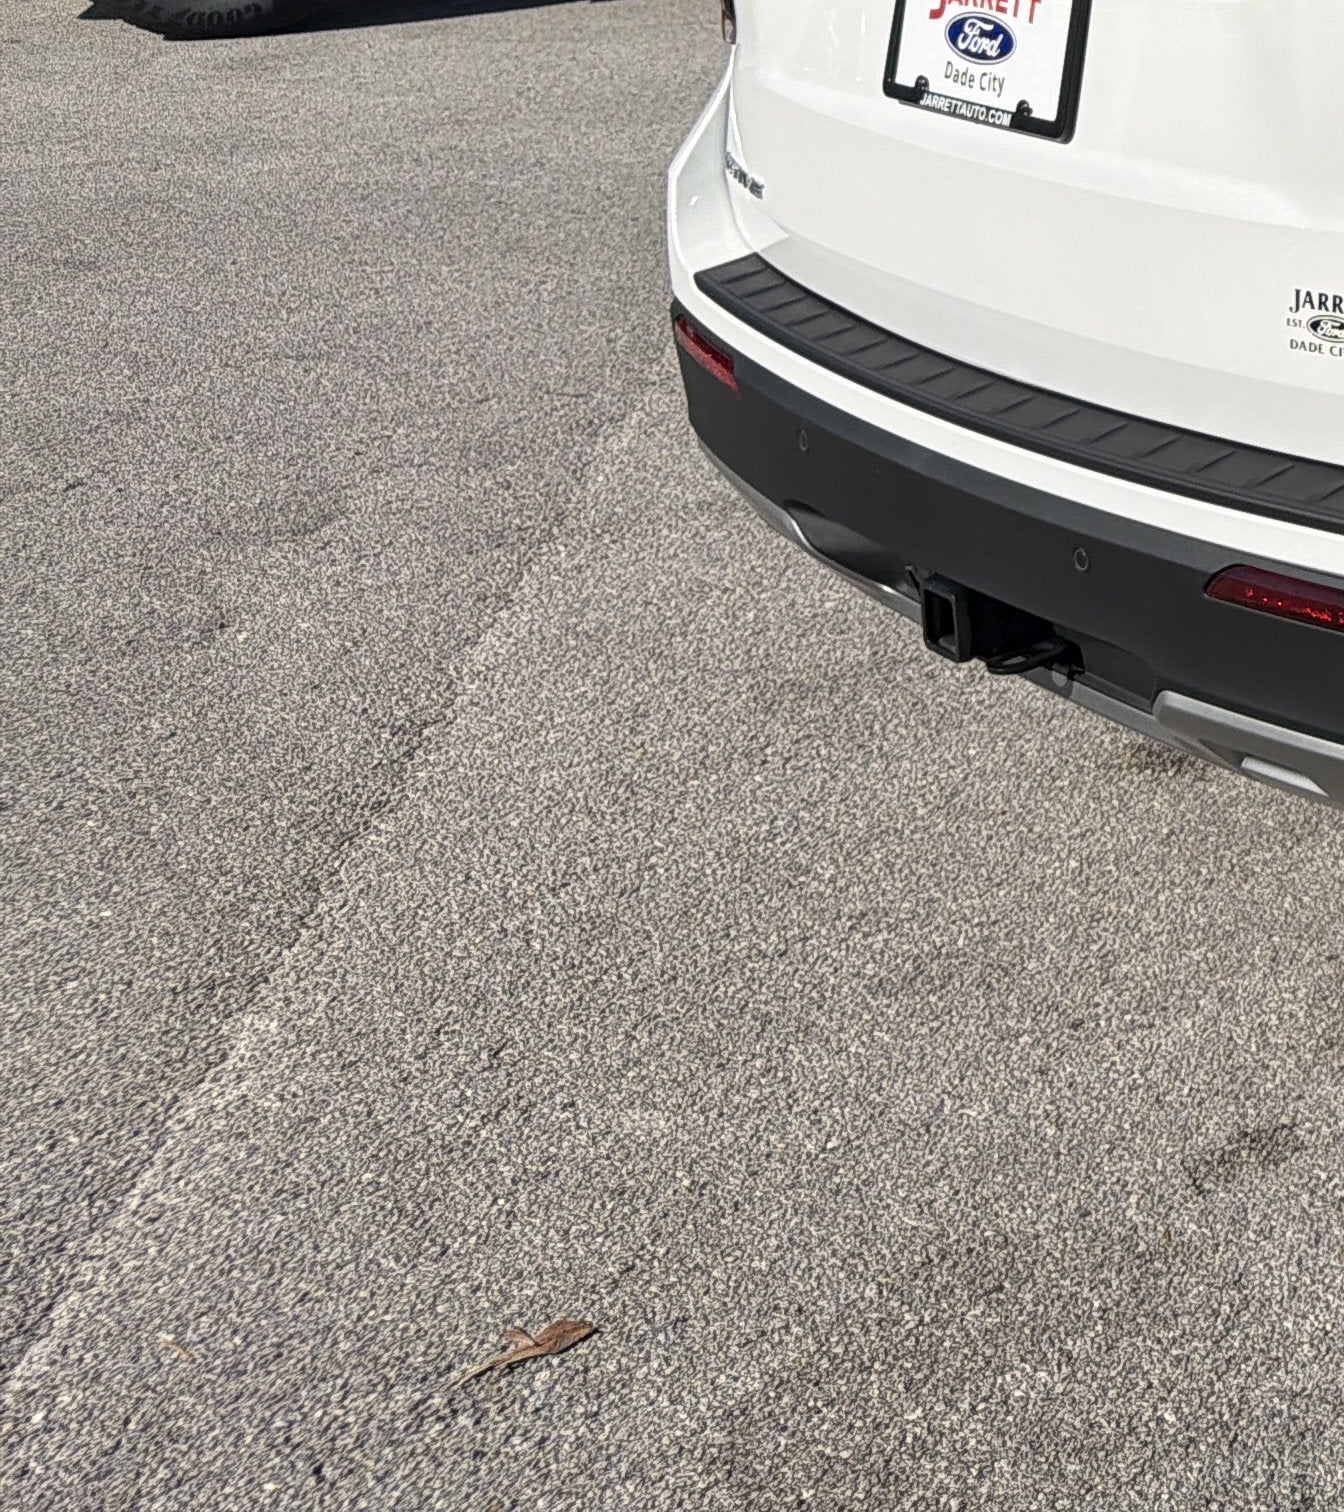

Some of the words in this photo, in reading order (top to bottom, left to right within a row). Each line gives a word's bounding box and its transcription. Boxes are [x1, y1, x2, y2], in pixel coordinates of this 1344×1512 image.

[958, 18, 1004, 57] Ford
[944, 61, 975, 89] Dade
[979, 72, 1006, 98] City
[919, 92, 1012, 127] JARRETTAUTO.COM
[1286, 317, 1306, 330] EST.
[1289, 339, 1325, 355] DADE
